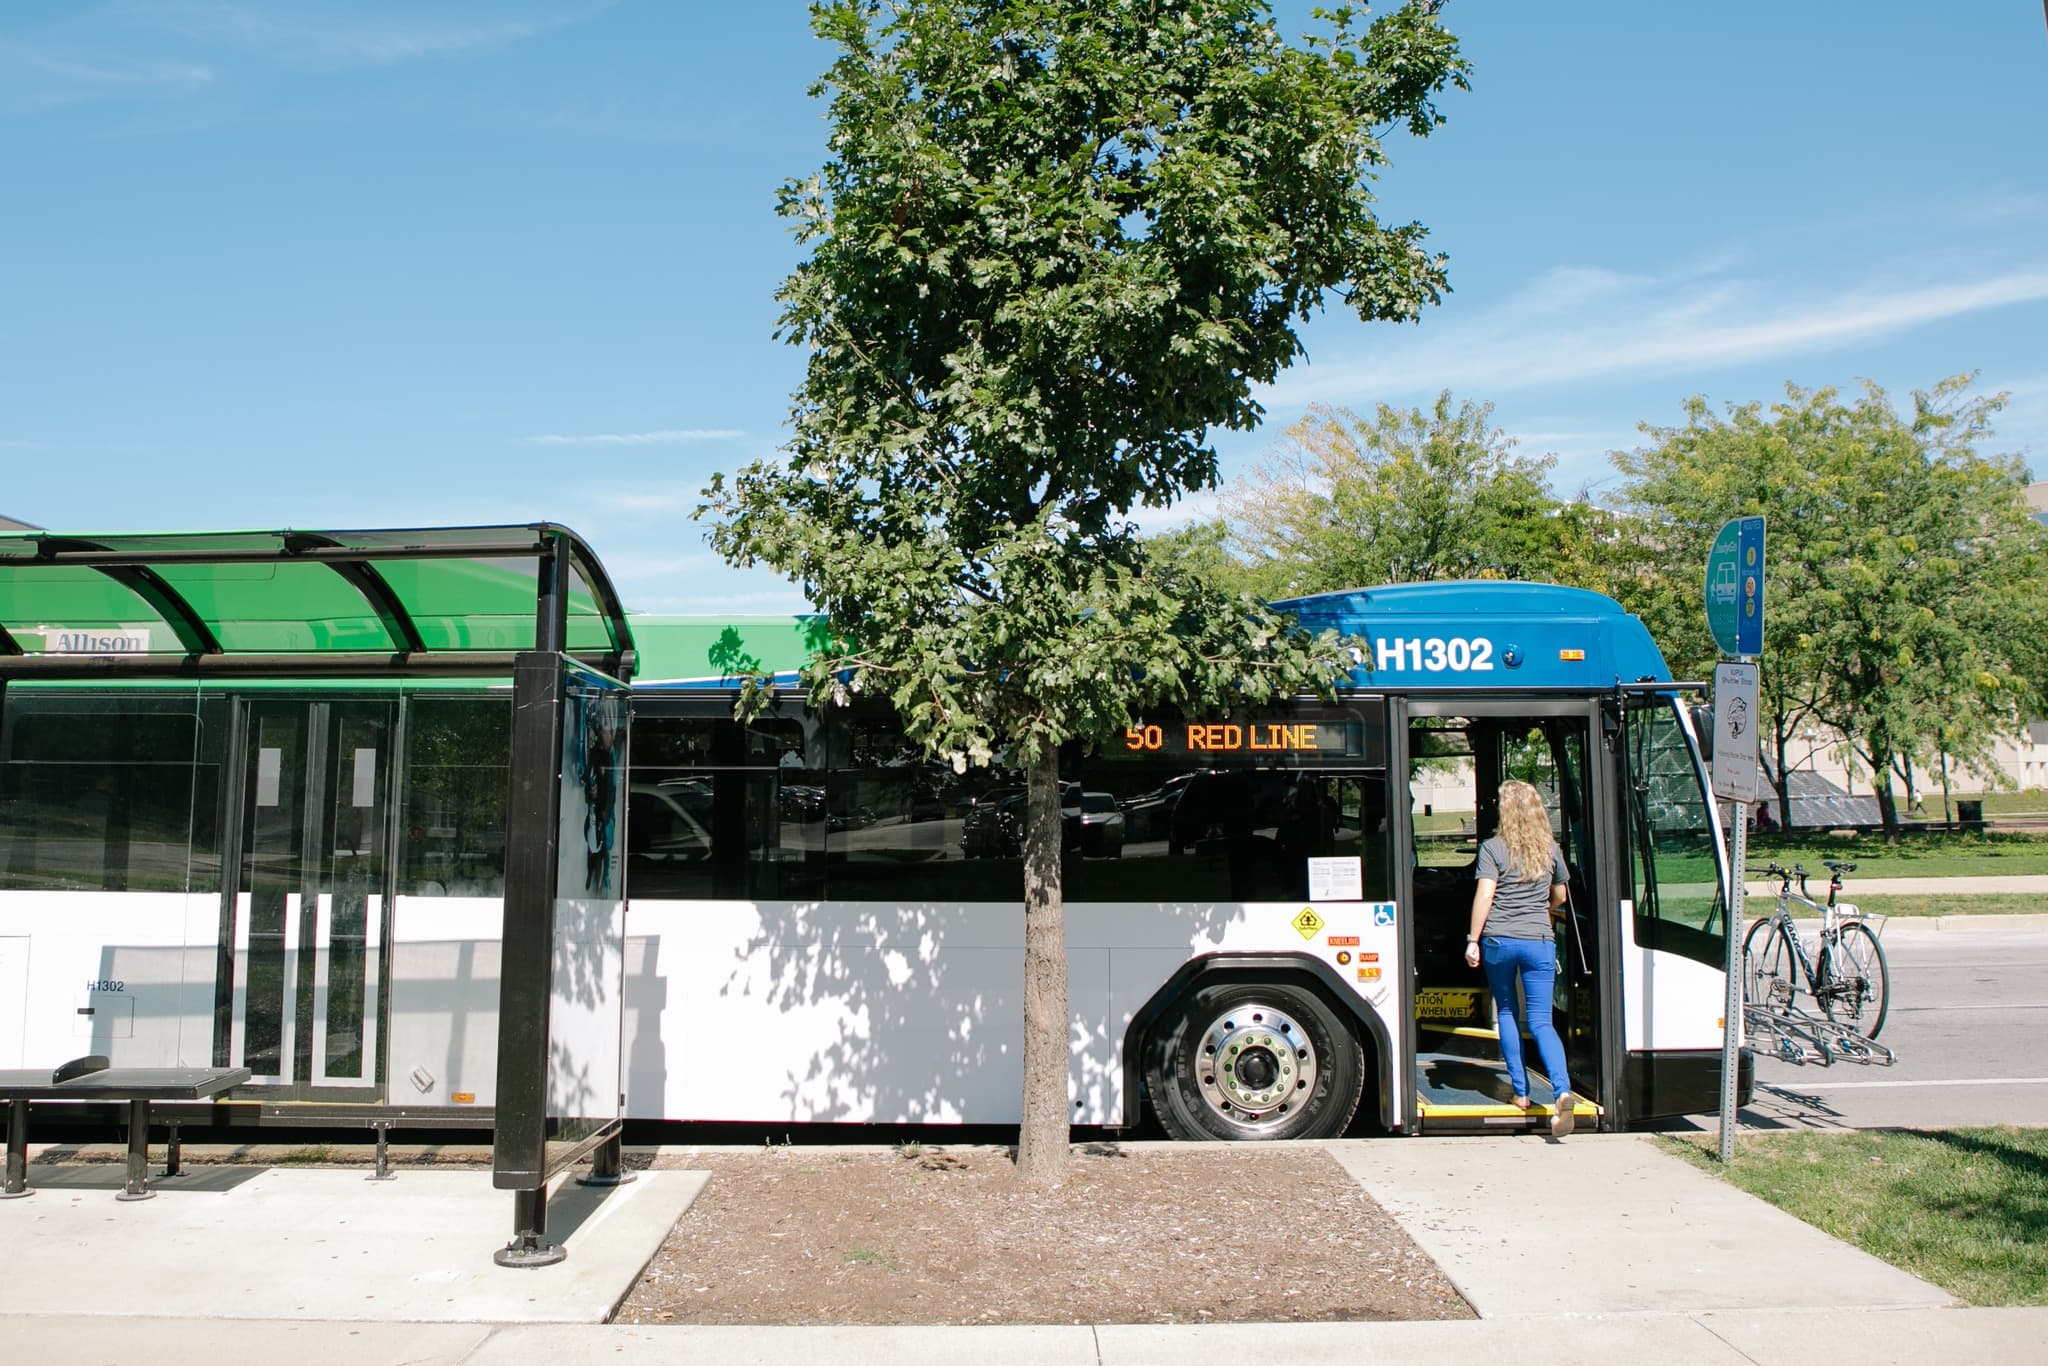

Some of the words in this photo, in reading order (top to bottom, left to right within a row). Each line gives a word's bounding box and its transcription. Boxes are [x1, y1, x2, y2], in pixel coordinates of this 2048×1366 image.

[57, 633, 146, 651] Allison
[1377, 638, 1494, 671] H1302
[1126, 725, 1162, 750] 50
[1188, 725, 1242, 750] RED
[1250, 725, 1318, 750] LINE
[1329, 936, 1359, 946] KNEELING
[1360, 952, 1378, 962] RAMP
[87, 980, 124, 992] H1302
[1415, 995, 1443, 1005] UTION
[1420, 1006, 1447, 1016] WHEN
[1449, 1007, 1469, 1016] WET
